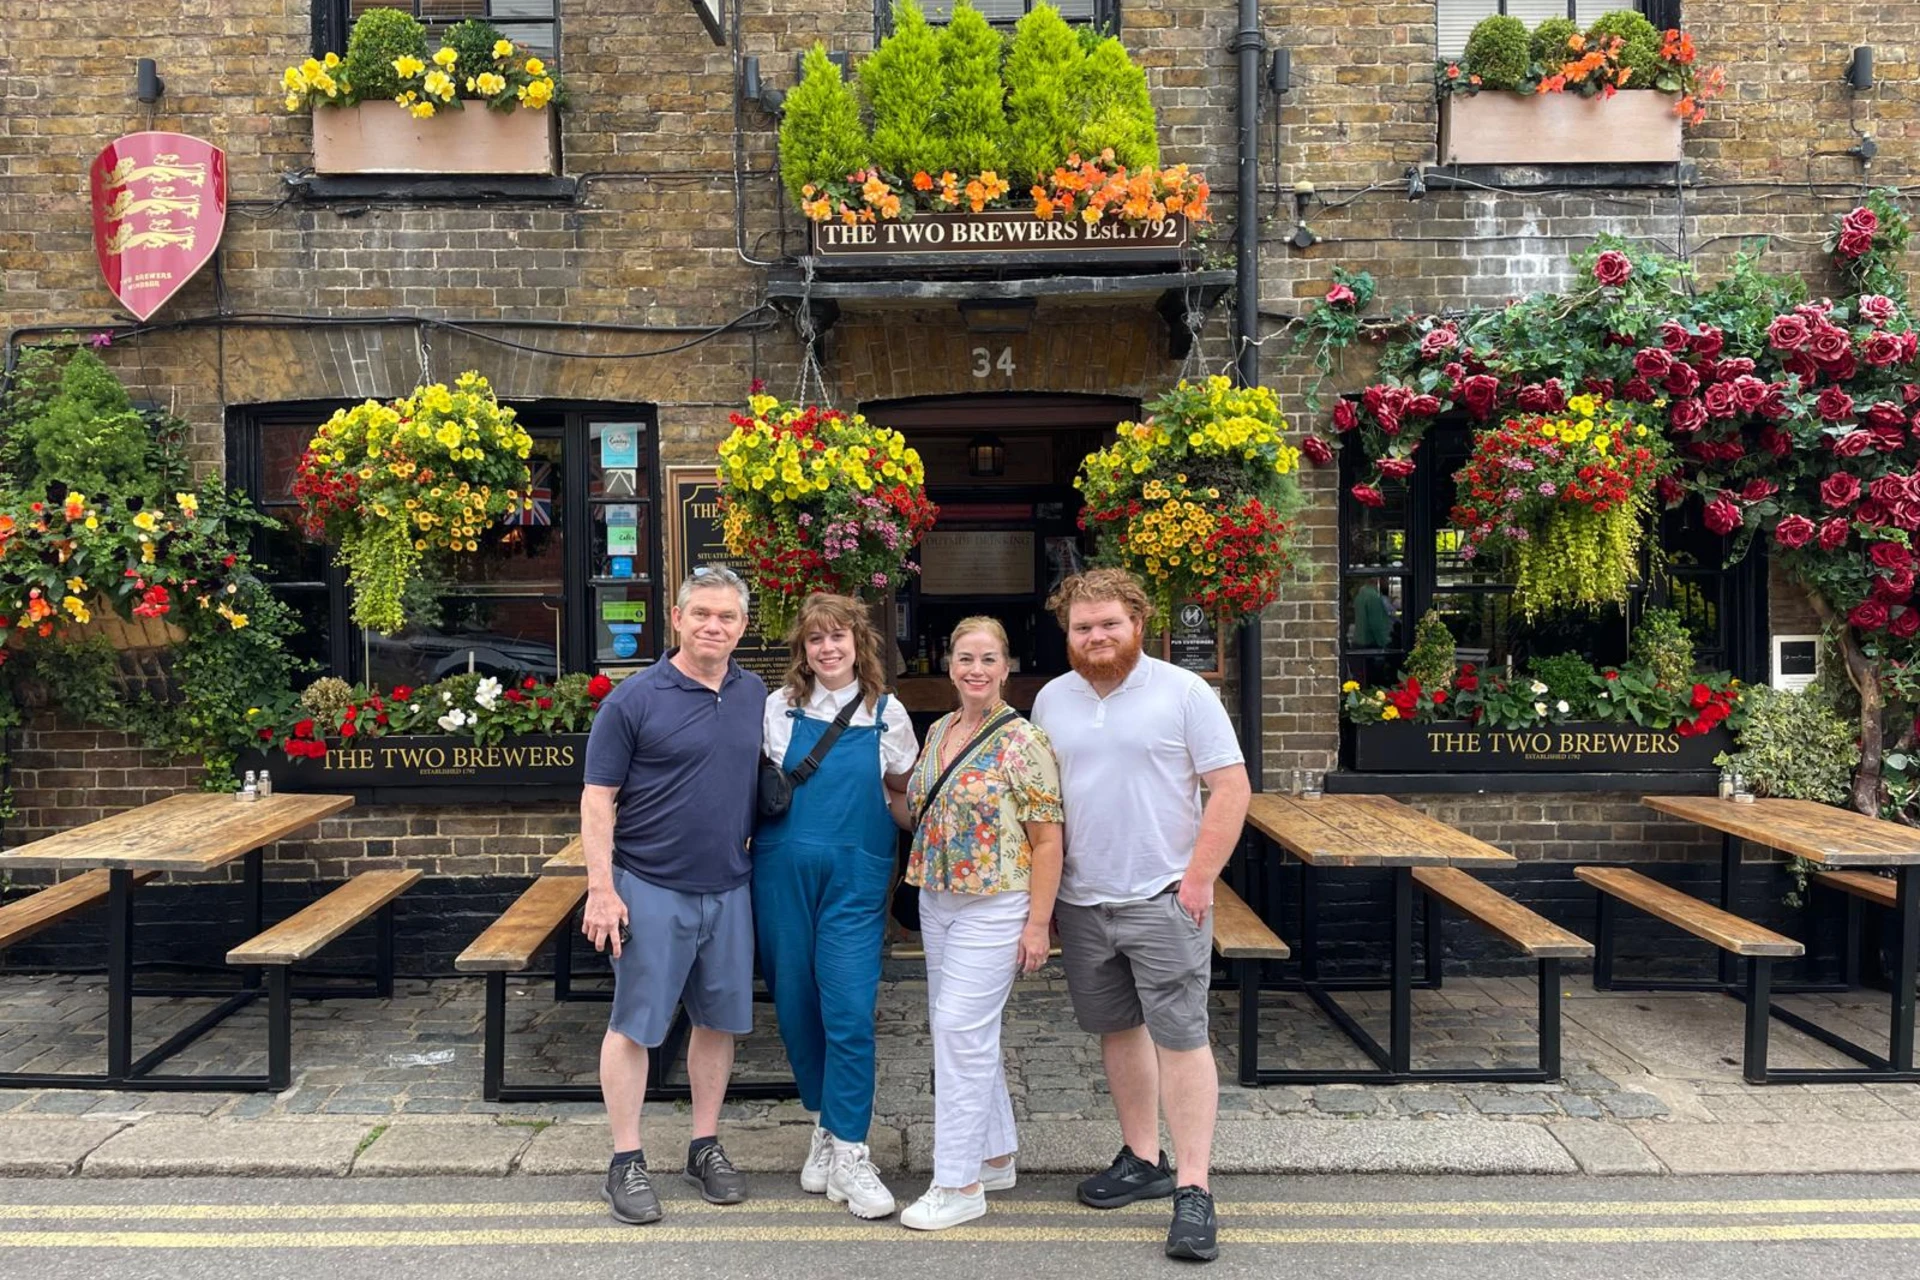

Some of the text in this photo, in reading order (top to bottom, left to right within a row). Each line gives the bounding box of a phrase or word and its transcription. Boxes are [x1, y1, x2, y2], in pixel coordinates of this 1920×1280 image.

[823, 224, 877, 245] THE
[883, 222, 945, 244] TWO
[951, 220, 1078, 243] BREWERS
[972, 346, 1016, 378] 34
[691, 503, 720, 518] THE
[1427, 732, 1680, 754] THE TWO BREWERS
[323, 745, 575, 770] THE TWO BREWERS
[1524, 753, 1567, 761] ESTABLISHED
[419, 768, 462, 776] ESTABLISHED
